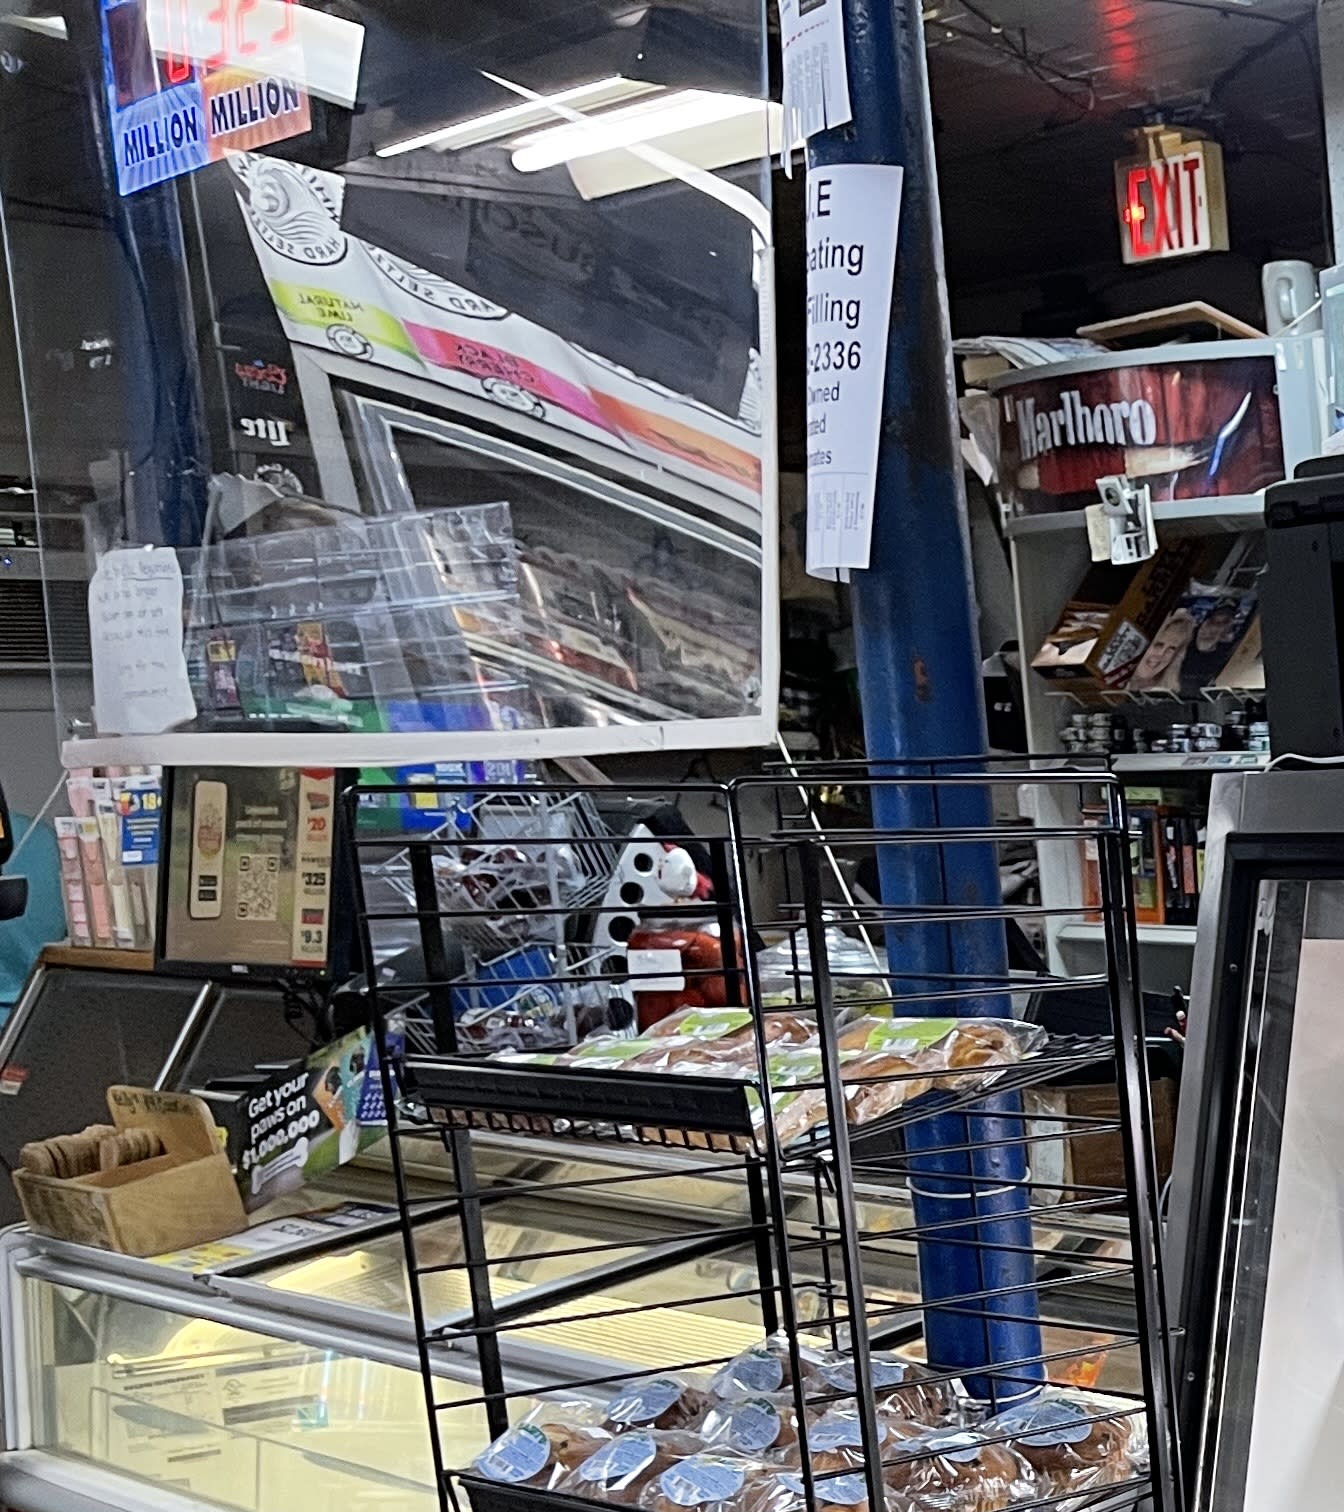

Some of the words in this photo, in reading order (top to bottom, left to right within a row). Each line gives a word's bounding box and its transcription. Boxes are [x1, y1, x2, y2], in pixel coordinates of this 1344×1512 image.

[210, 79, 299, 136] MILLION
[123, 106, 198, 167] MILLION
[1124, 158, 1200, 258] EXIT
[807, 341, 862, 377] -2336
[1015, 390, 1156, 460] Marlboro
[249, 1090, 272, 1118] Get
[273, 1072, 309, 1106] your
[251, 1106, 286, 1144] paws
[286, 1095, 307, 1117] on
